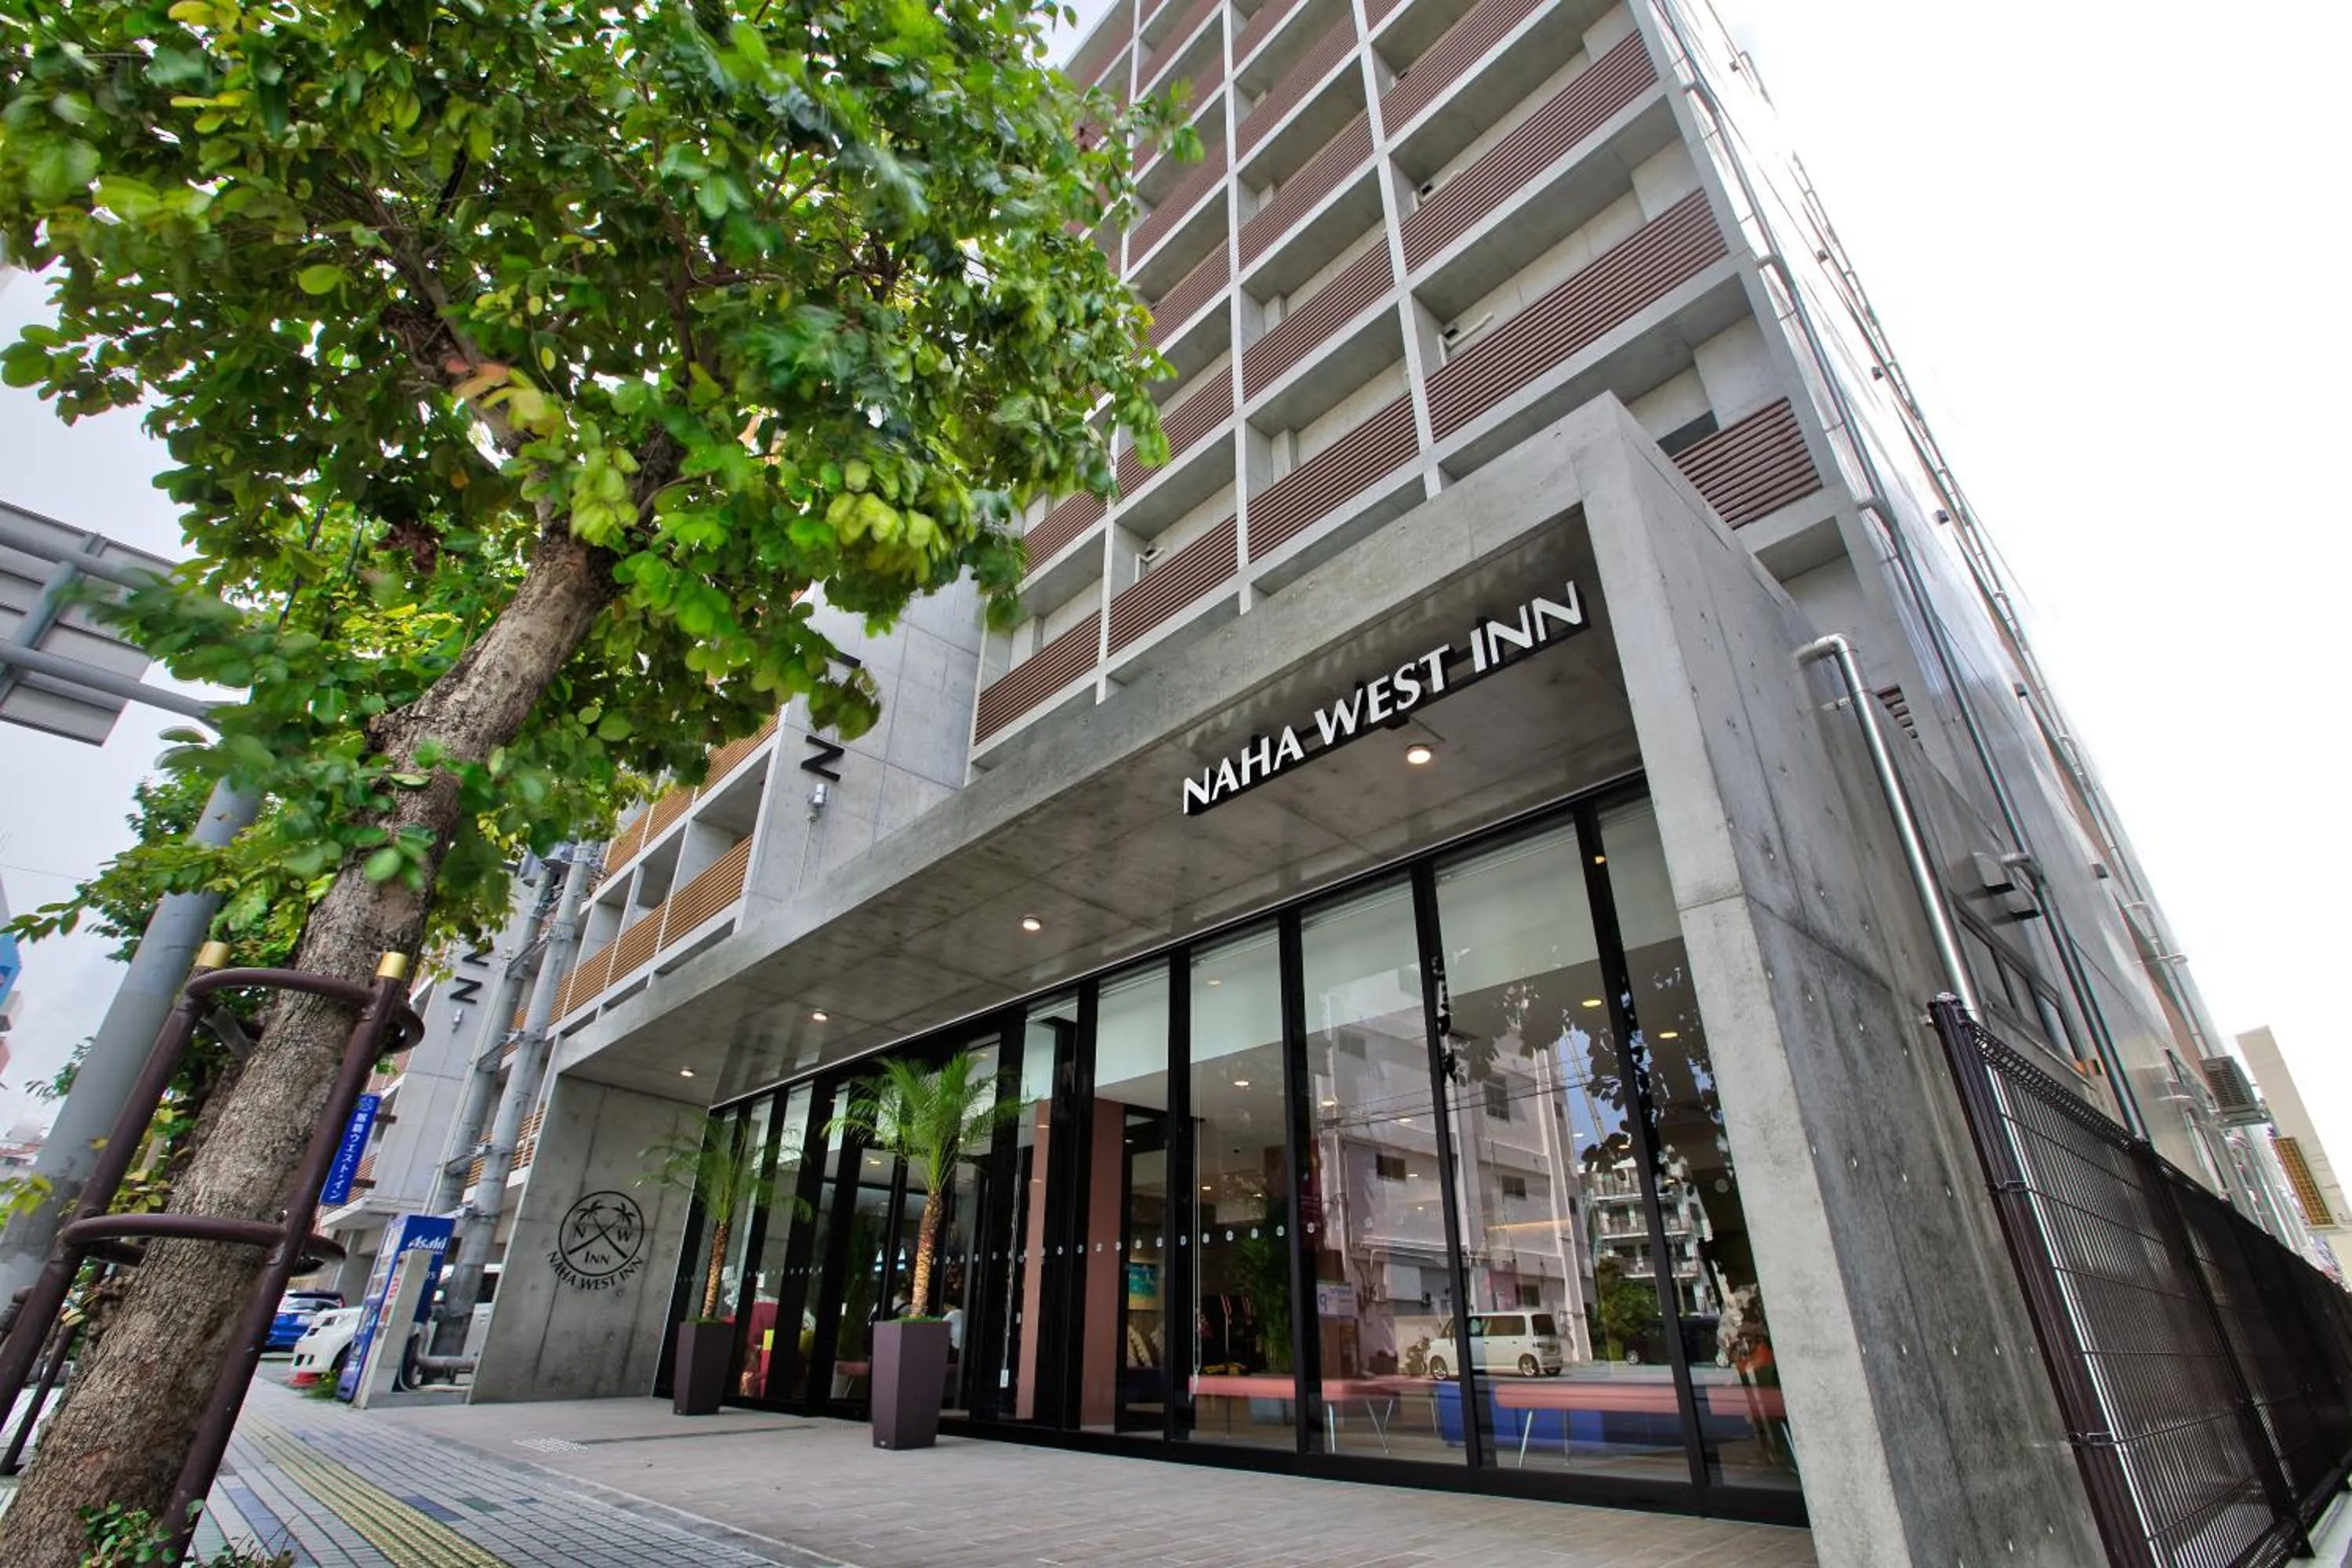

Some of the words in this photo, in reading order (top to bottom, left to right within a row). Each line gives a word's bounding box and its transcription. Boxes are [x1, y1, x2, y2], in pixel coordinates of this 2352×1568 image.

[1182, 725, 1305, 815] NAHA
[1313, 644, 1450, 746] WEST
[1470, 580, 1584, 673] INN
[407, 1235, 448, 1250] Asahi
[572, 1221, 587, 1239] N
[547, 1251, 576, 1287] NAHA
[578, 1274, 616, 1290] WEST
[618, 1256, 644, 1282] INN
